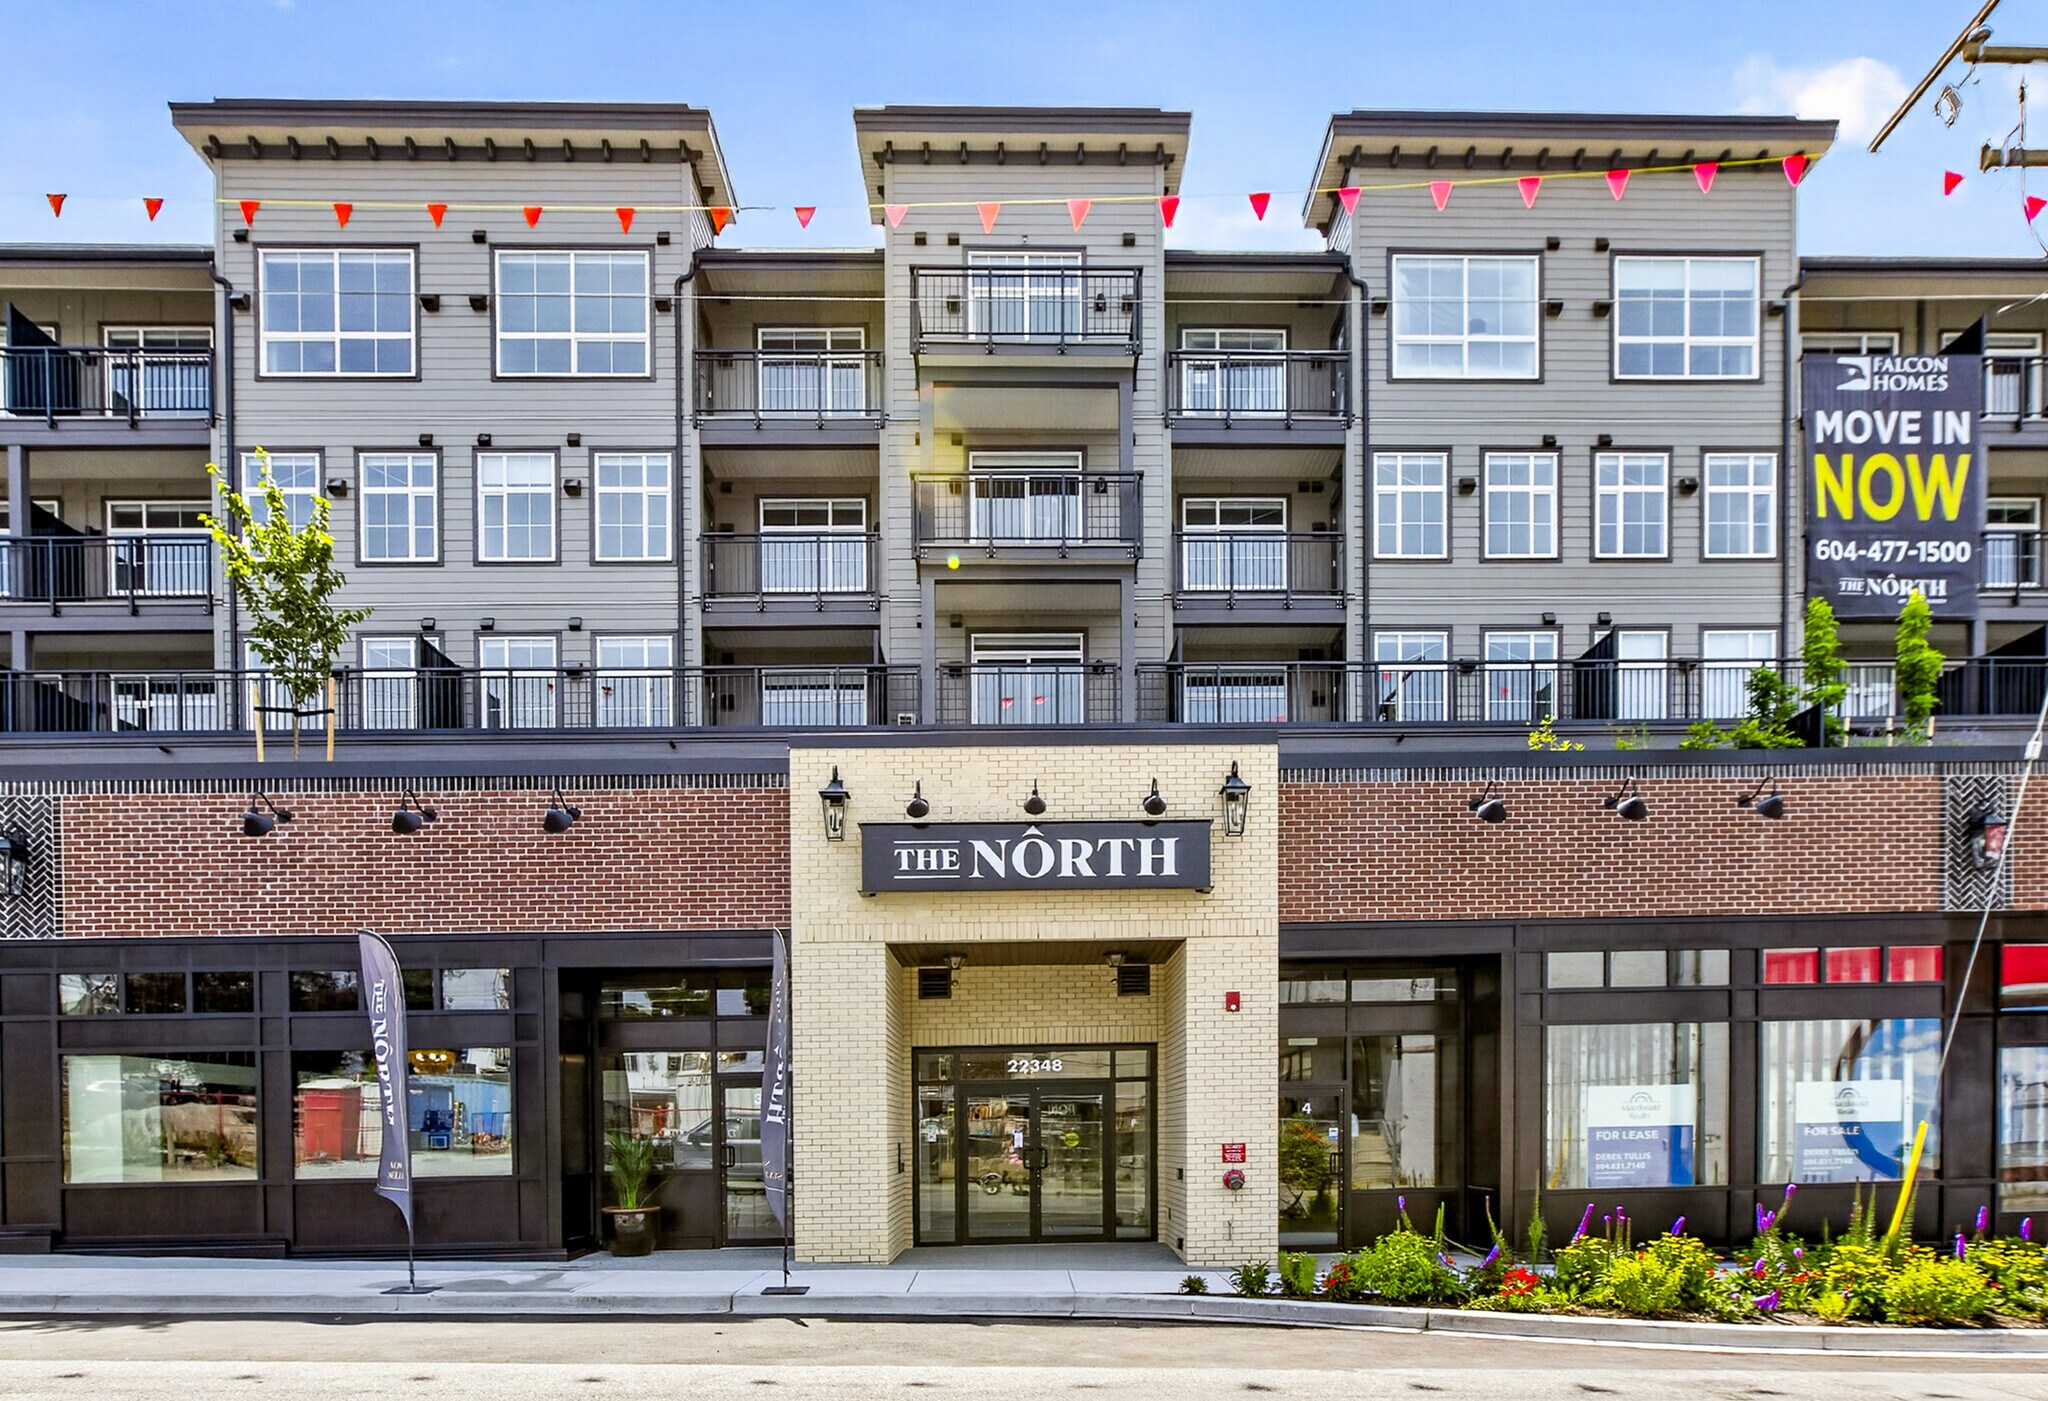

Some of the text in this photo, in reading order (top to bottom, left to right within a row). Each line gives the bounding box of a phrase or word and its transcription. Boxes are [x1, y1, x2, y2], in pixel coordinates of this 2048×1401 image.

[1873, 357, 1948, 374] FALCON
[1873, 374, 1948, 391] HOMES
[1815, 410, 1971, 445] MOVE IN
[1813, 453, 1972, 522] NOW
[1815, 539, 1972, 564] 604-477-1500
[1838, 579, 1865, 592] THE
[893, 848, 961, 872] THE
[1007, 1058, 1063, 1073] 22348
[1301, 1102, 1312, 1115] 4
[1595, 1129, 1659, 1141] FOR LEASE
[1804, 1126, 1861, 1136] FOR SALE
[1595, 1152, 1623, 1161] DEREK
